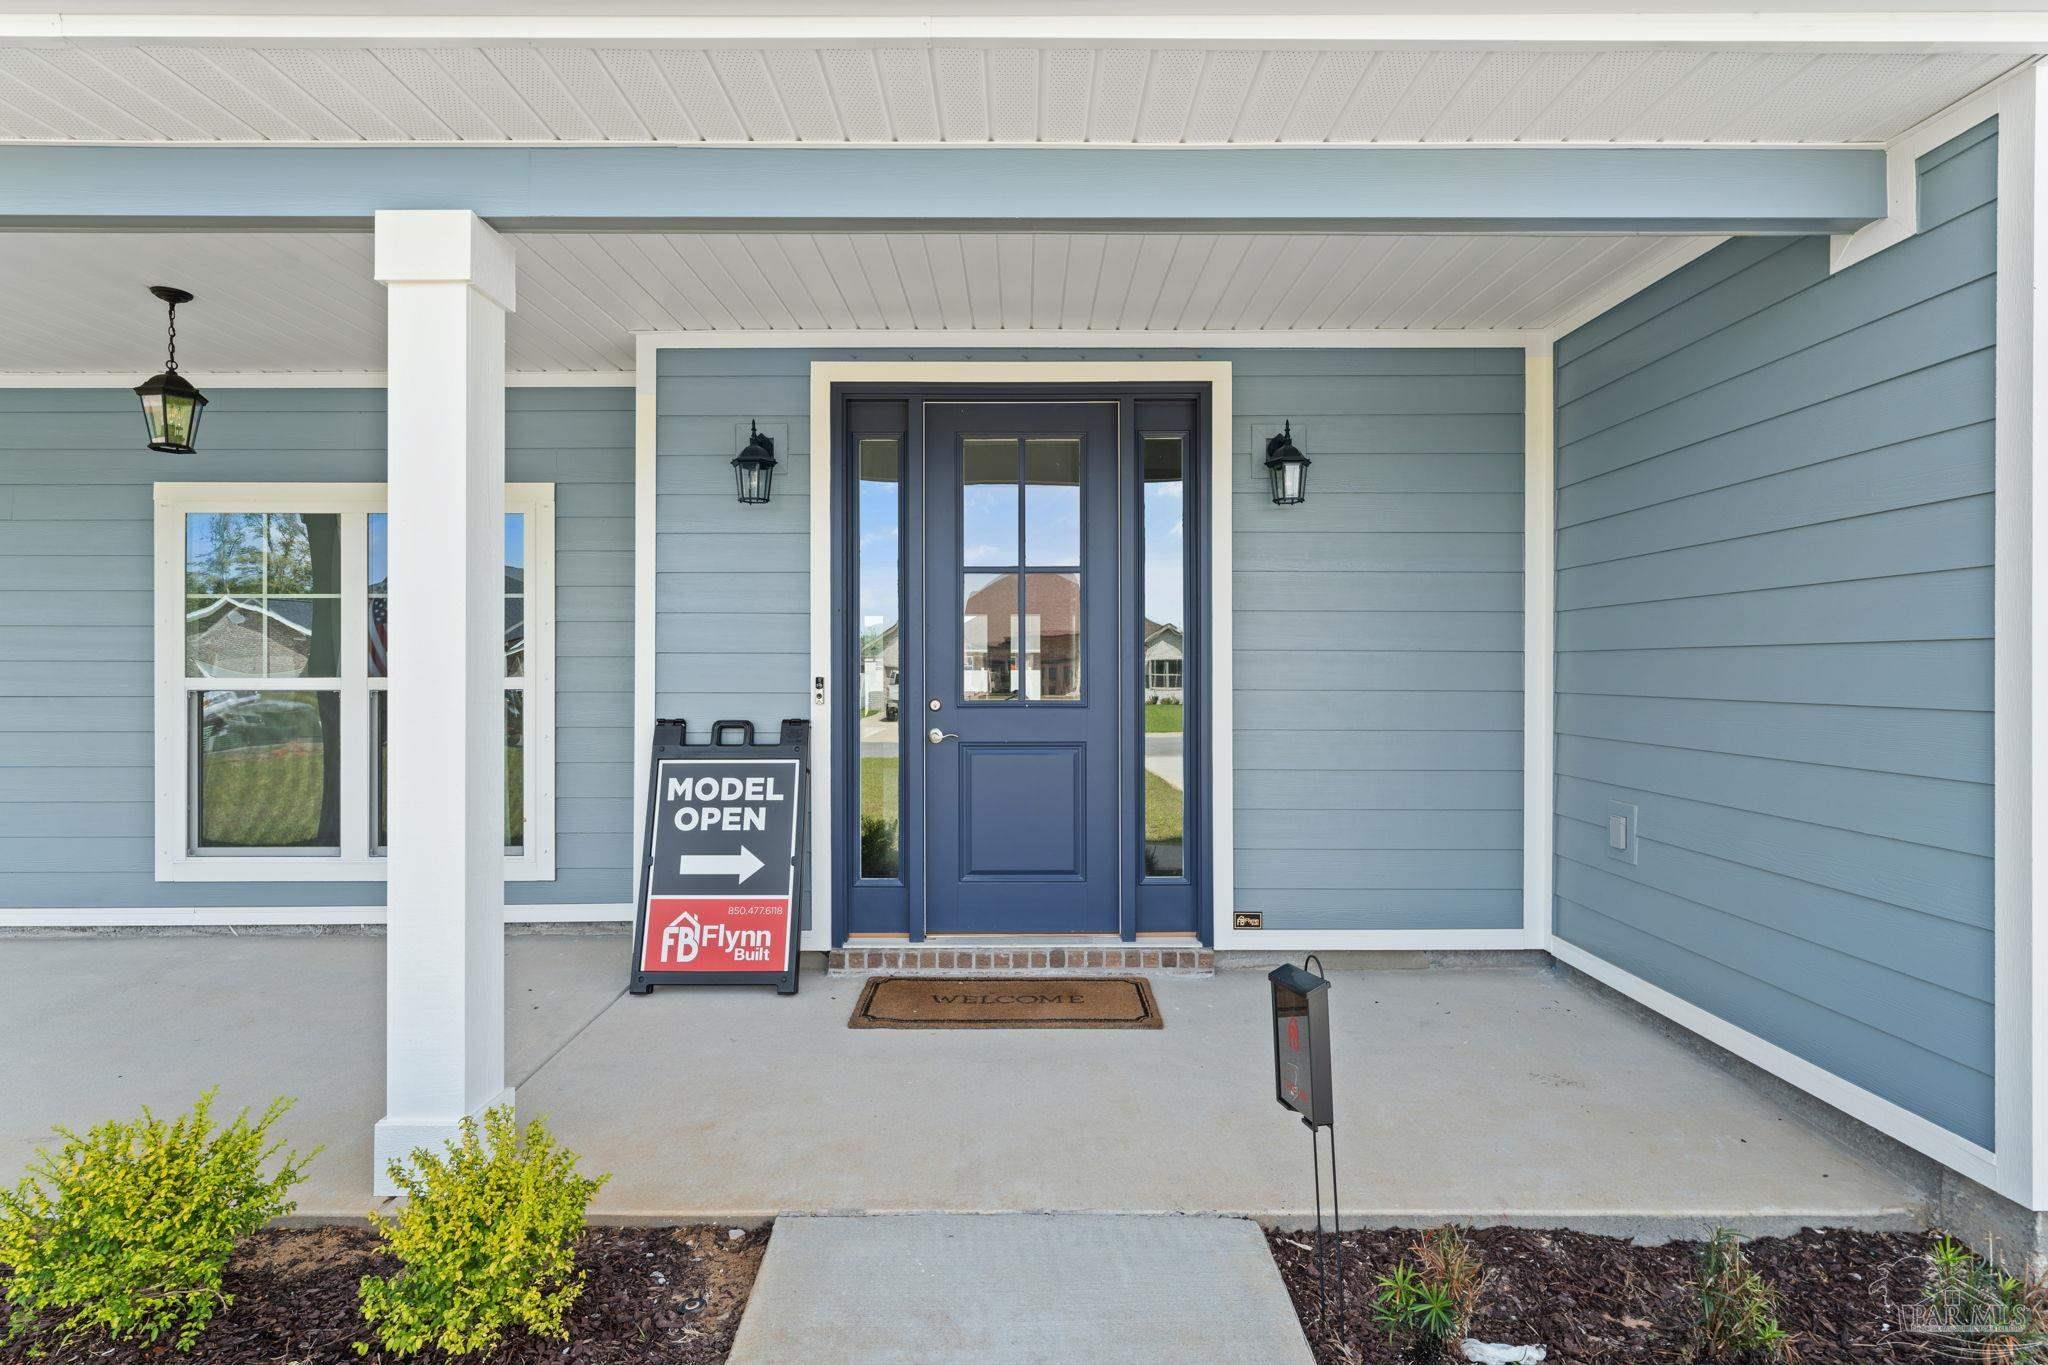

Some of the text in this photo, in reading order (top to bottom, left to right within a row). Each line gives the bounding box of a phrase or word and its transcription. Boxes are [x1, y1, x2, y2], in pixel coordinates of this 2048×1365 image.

[667, 777, 784, 801] MODEL
[674, 806, 766, 831] OPEN
[728, 906, 783, 915] 850.477.6118
[702, 923, 771, 953] Flynn
[734, 948, 770, 961] Built
[931, 994, 1085, 1004] WELCOME
